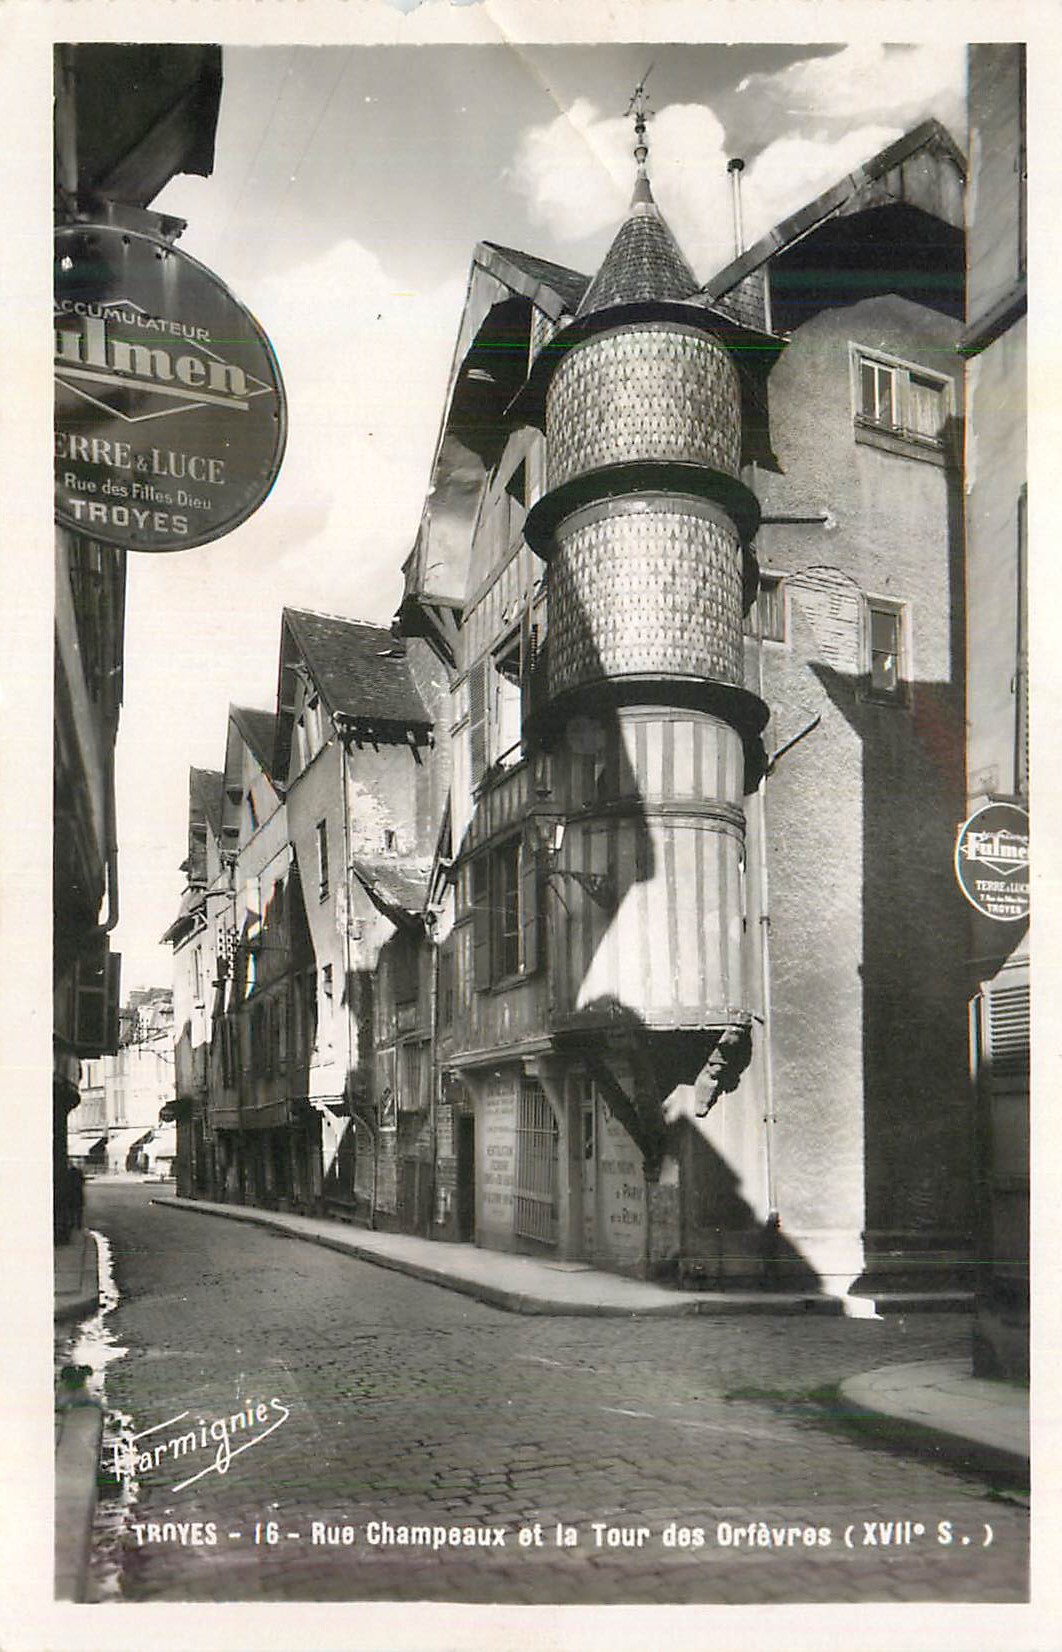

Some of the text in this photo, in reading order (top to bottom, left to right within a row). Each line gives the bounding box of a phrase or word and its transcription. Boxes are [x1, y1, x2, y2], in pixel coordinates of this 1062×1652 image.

[136, 455, 148, 471] &
[152, 448, 225, 485] LUCE
[64, 472, 212, 510] Rue des Filles Dieu
[68, 498, 188, 534] TROYES
